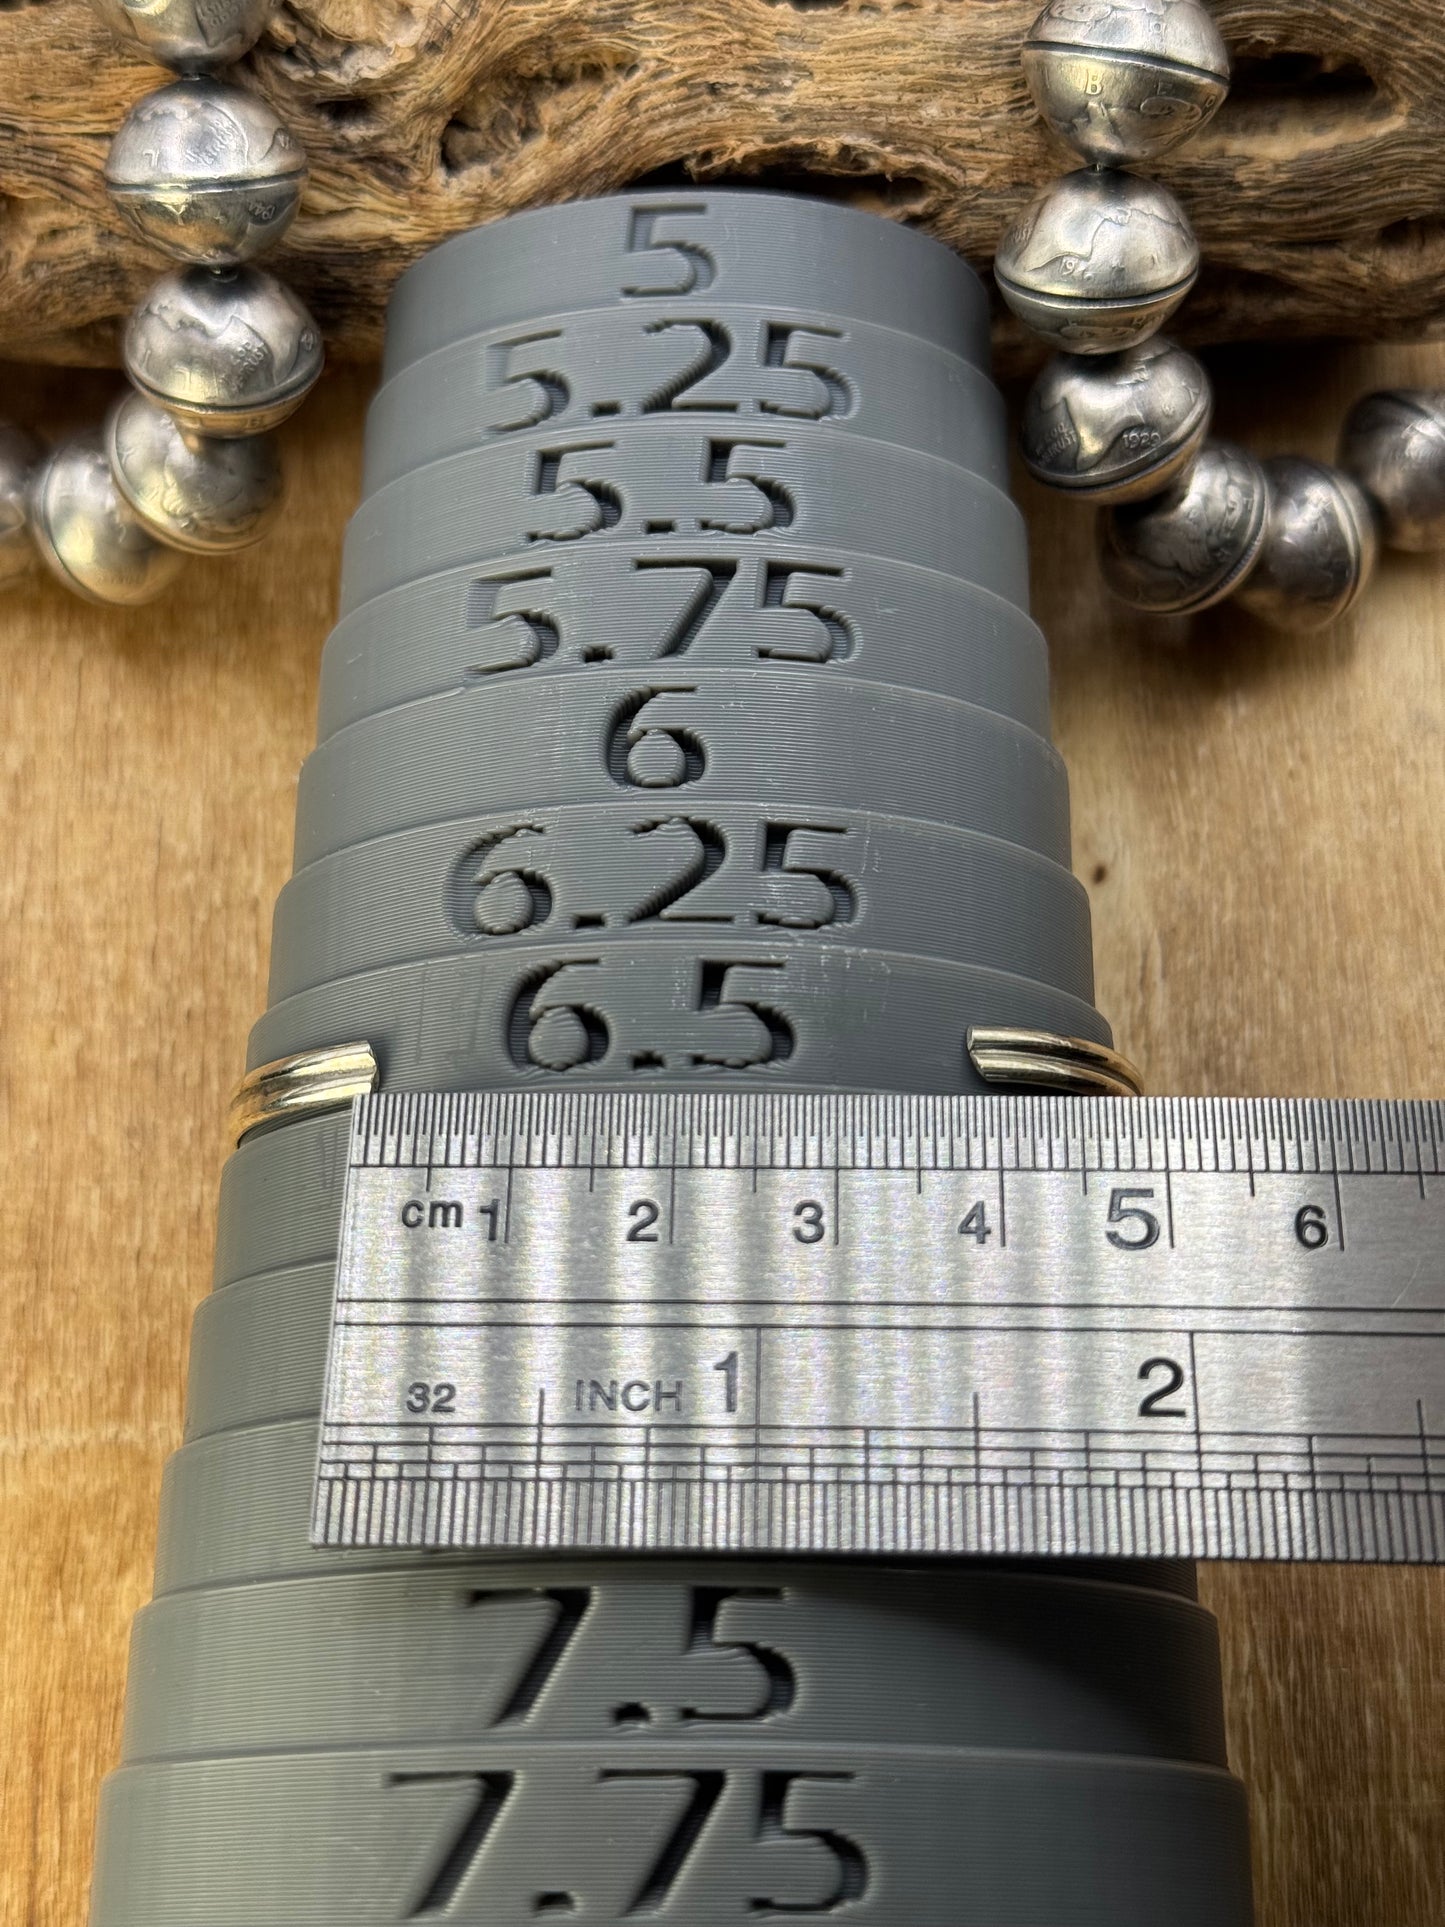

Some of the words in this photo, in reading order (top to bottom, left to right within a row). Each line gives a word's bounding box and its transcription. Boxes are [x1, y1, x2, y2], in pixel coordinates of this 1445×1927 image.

[621, 203, 718, 299] 5
[483, 317, 861, 436] 5.25
[521, 437, 800, 544] 5.5
[464, 557, 863, 680] 5.75
[601, 684, 712, 792] 6
[442, 815, 867, 943] 6.25
[501, 956, 800, 1075] 6.5
[400, 1198, 464, 1229] cm
[479, 1197, 501, 1242] 1
[626, 1198, 661, 1243] 2
[791, 1198, 826, 1245] 3
[957, 1199, 992, 1245] 4
[1104, 1187, 1160, 1251] 5
[1293, 1203, 1329, 1250] 6
[405, 1381, 457, 1415] 32
[574, 1378, 684, 1414] INCH
[712, 1350, 741, 1414] 1
[1136, 1356, 1188, 1418] 2
[463, 1585, 800, 1729] 7.5
[381, 1768, 877, 1919] 7.75
